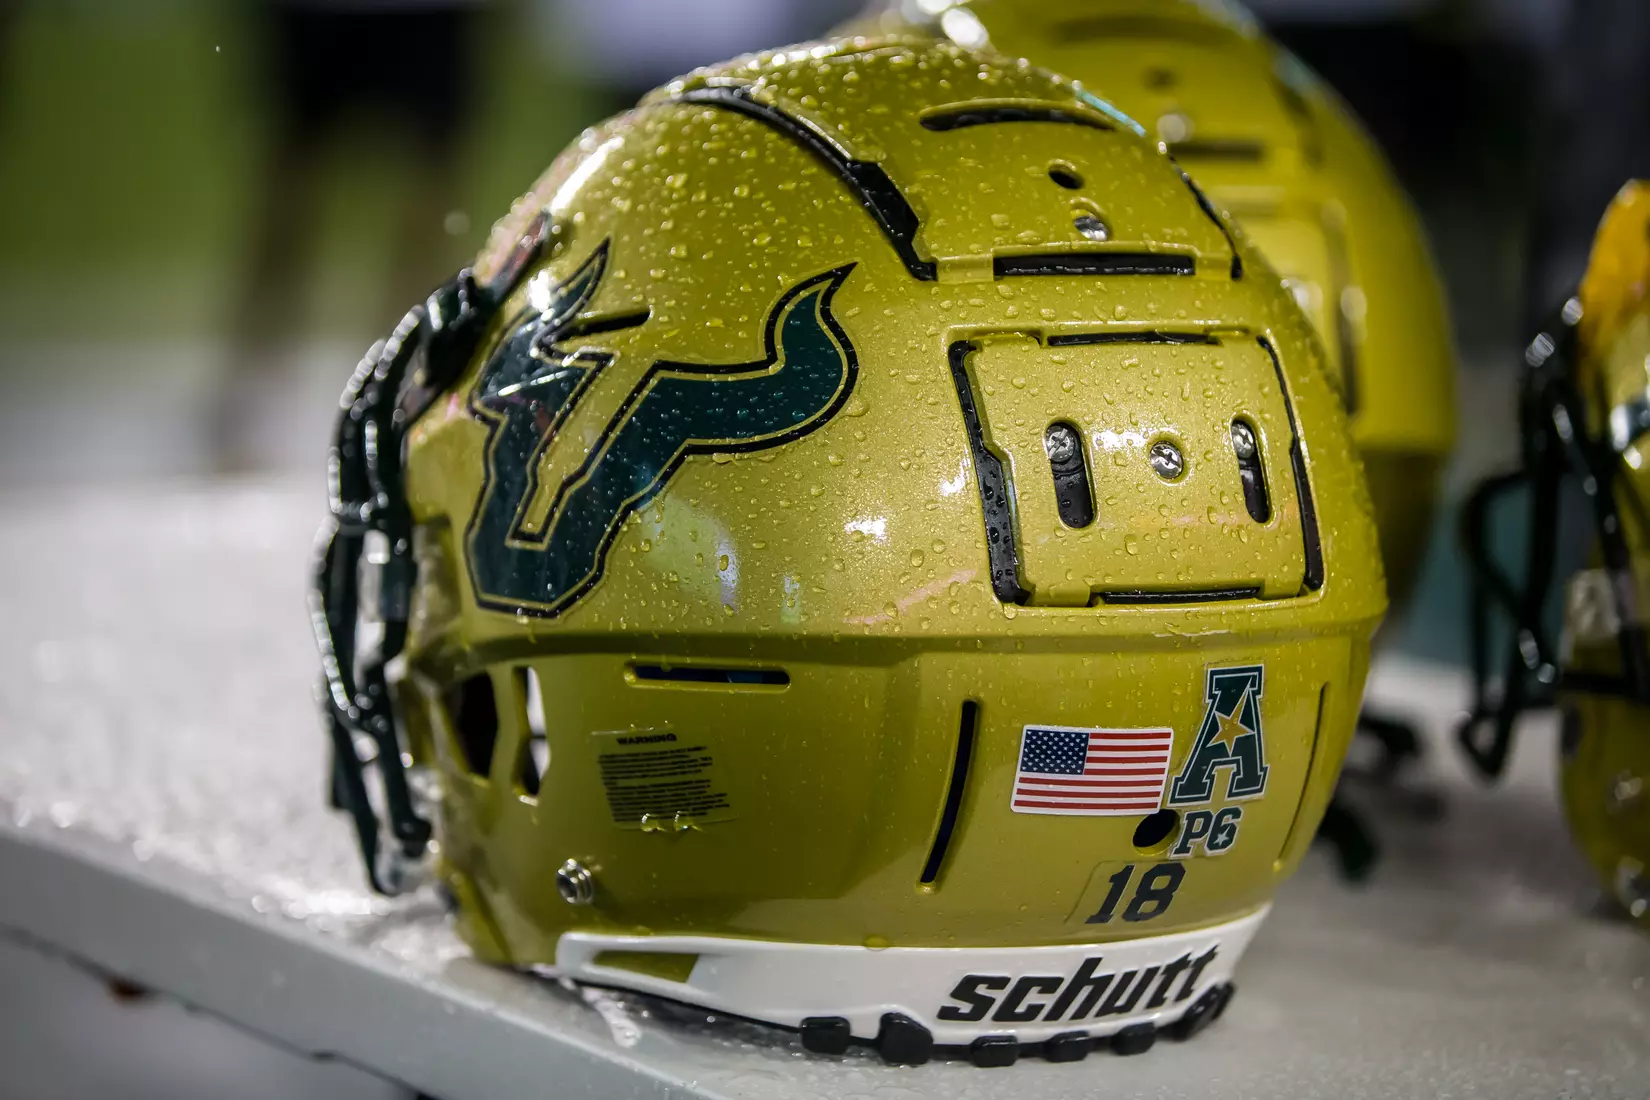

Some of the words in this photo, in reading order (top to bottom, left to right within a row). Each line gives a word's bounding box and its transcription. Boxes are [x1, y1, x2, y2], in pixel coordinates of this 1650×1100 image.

[617, 733, 677, 745] WARNING
[1169, 665, 1268, 805] A
[1172, 807, 1243, 859] P6
[1085, 863, 1186, 924] 18
[938, 945, 1220, 1022] schutt
